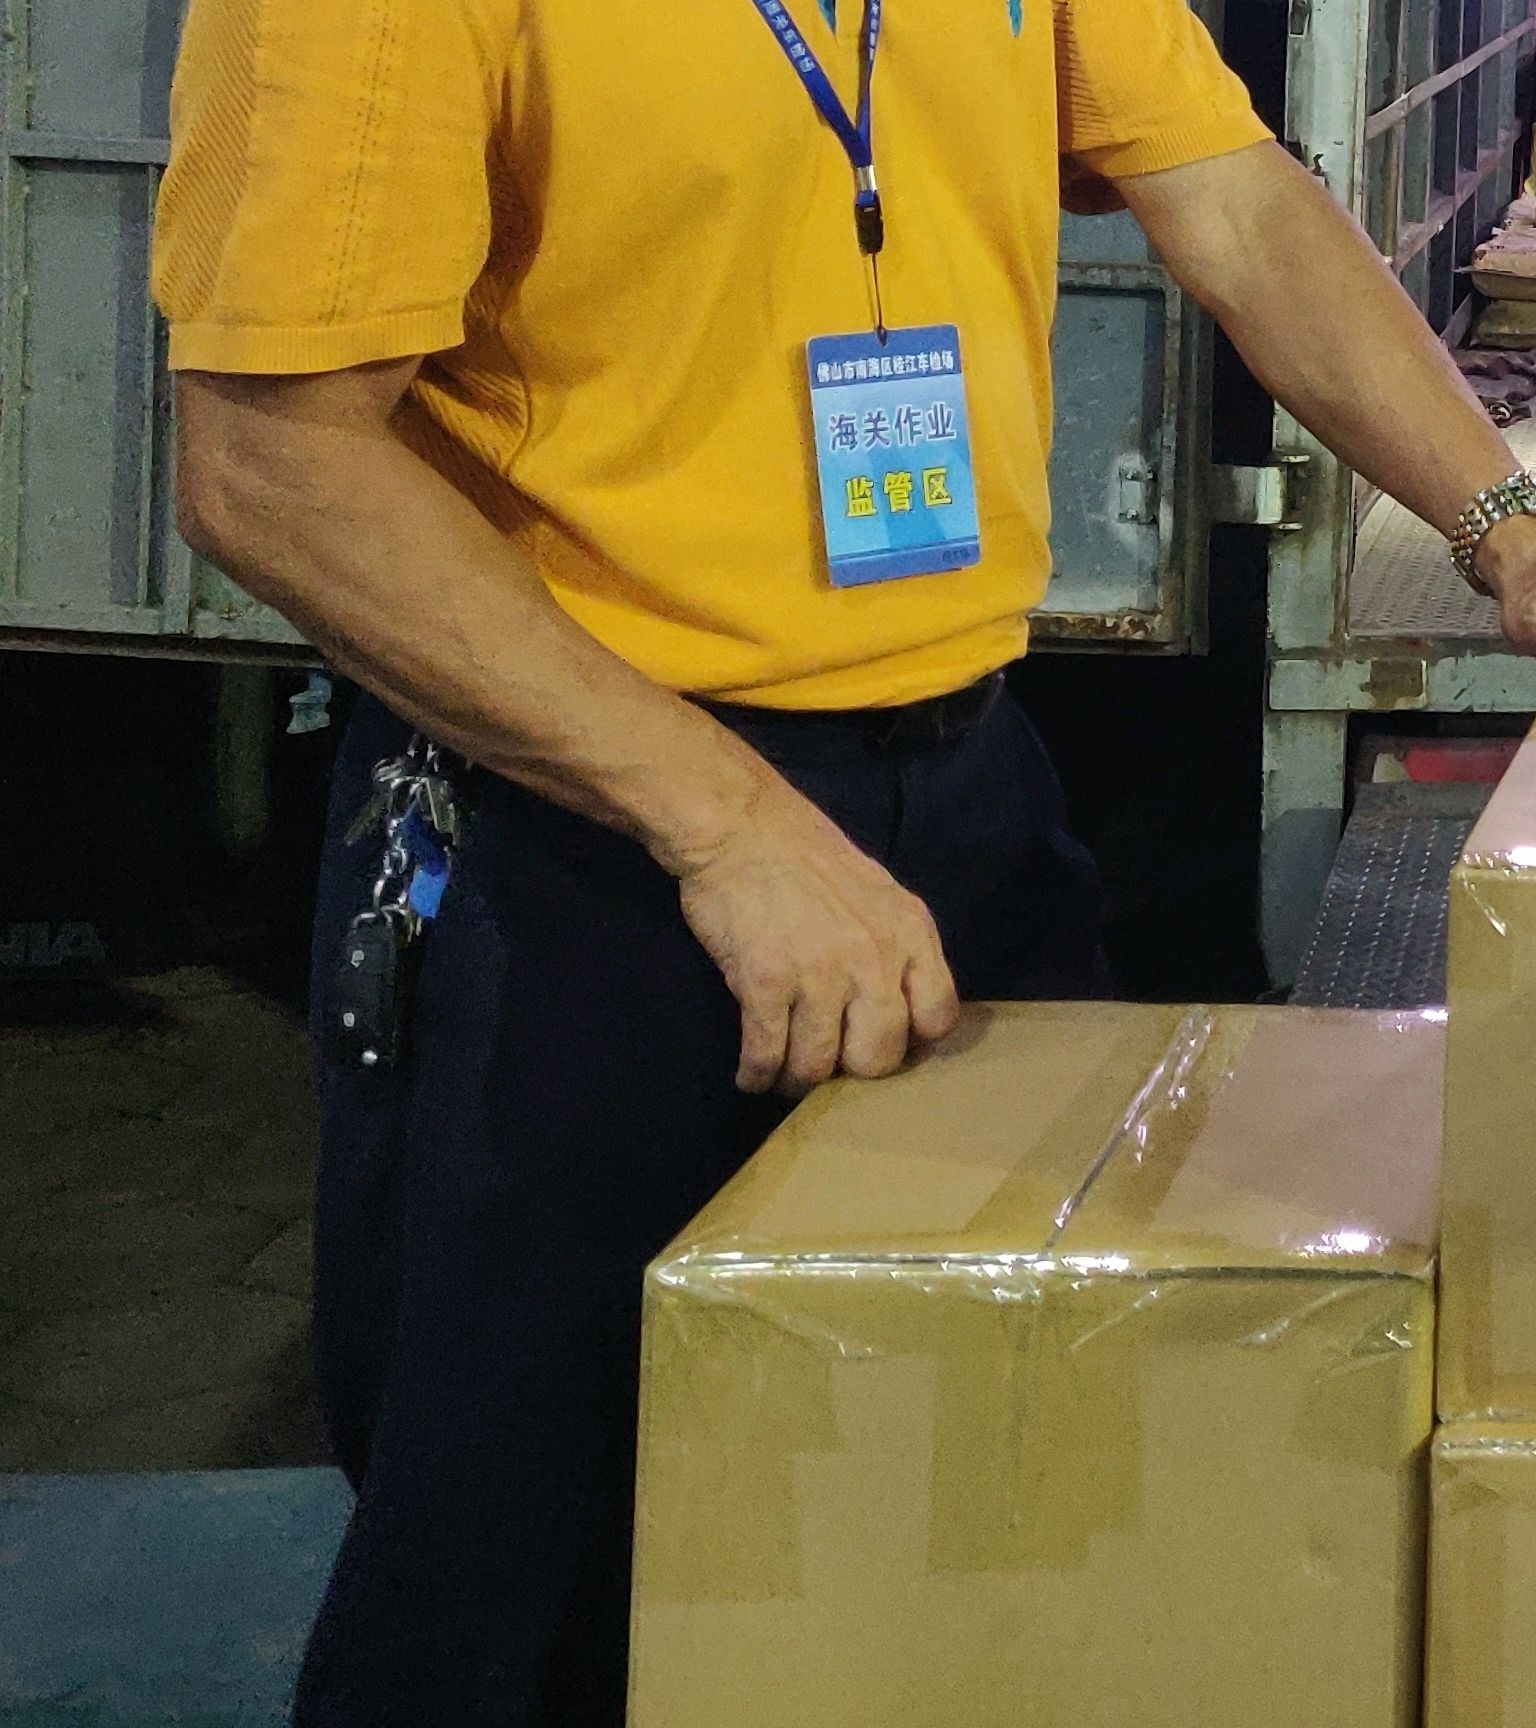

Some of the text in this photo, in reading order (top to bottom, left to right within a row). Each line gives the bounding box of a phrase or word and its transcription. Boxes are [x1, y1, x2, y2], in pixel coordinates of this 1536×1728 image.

[830, 402, 957, 452] 海关作业
[845, 467, 952, 518] 监管区
